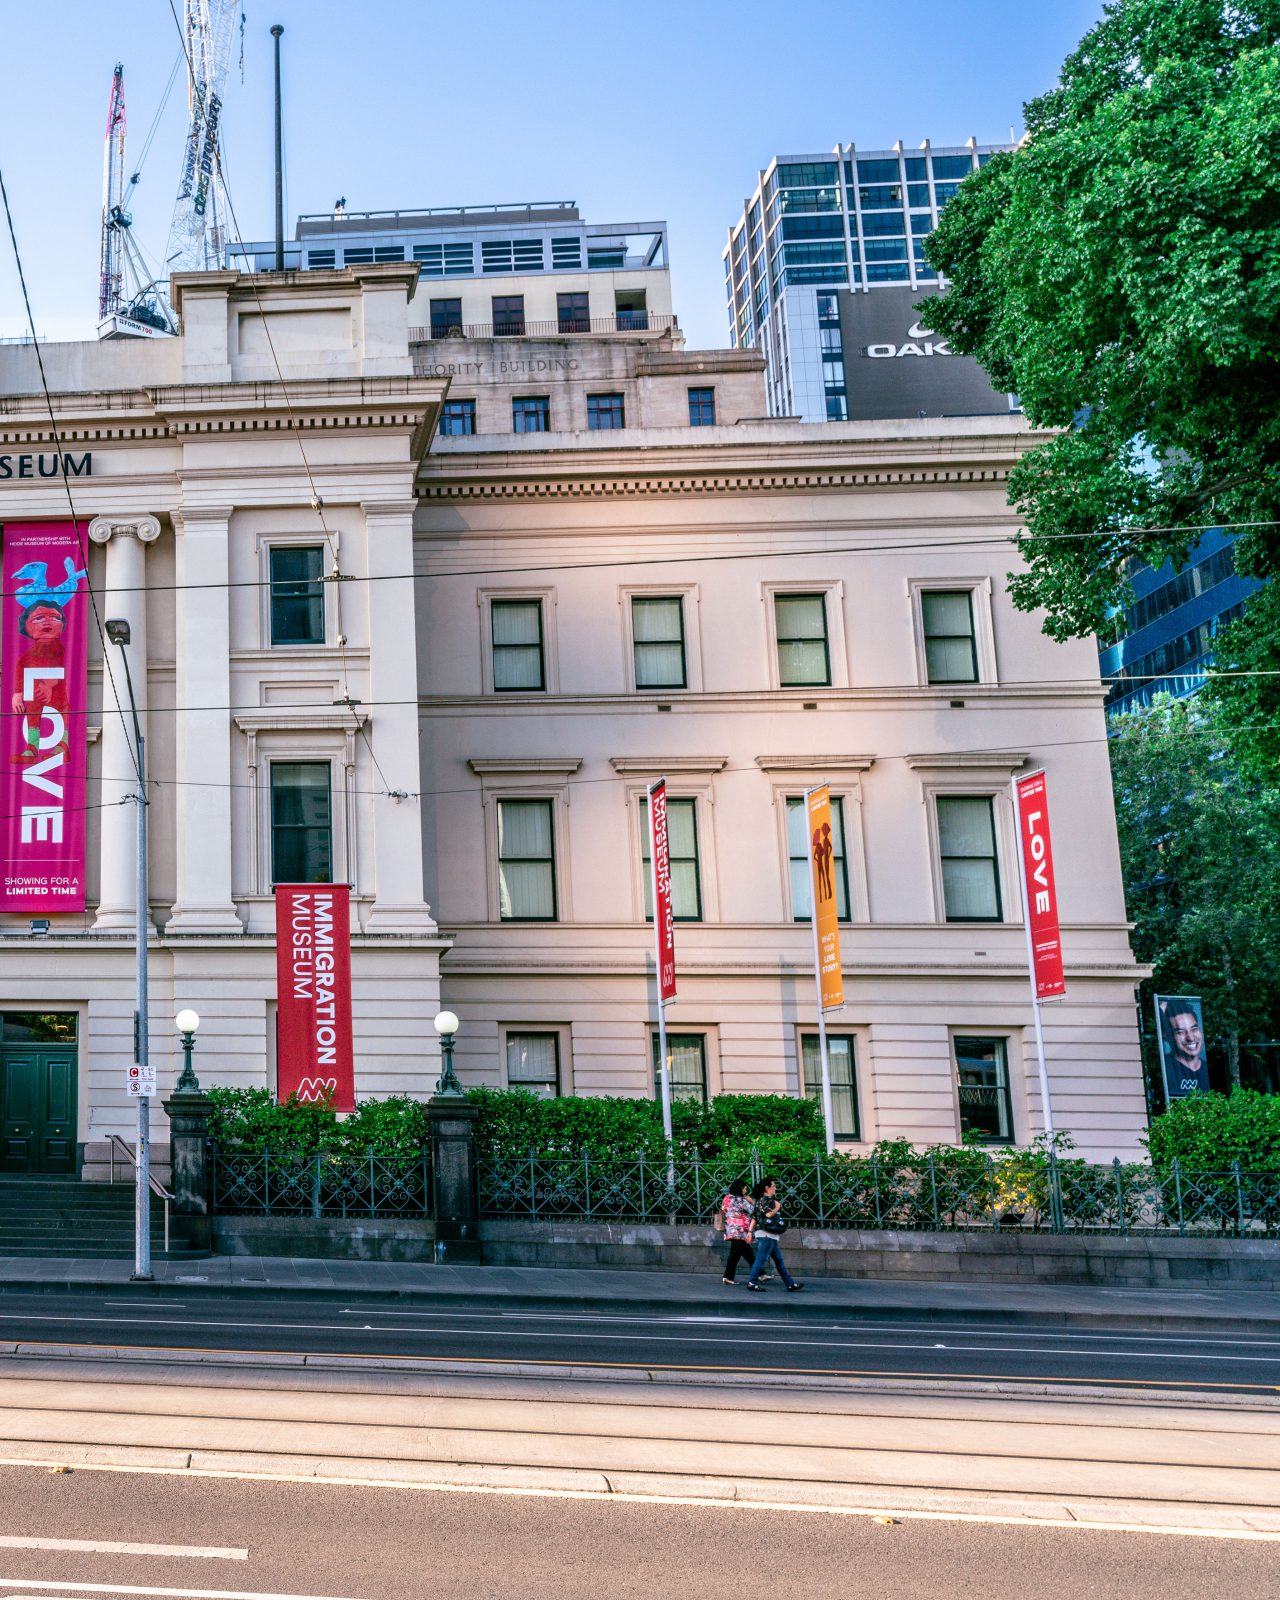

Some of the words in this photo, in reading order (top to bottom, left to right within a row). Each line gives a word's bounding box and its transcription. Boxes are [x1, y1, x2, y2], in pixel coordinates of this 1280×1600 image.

[124, 320, 141, 330] FORM
[867, 341, 963, 358] OAK
[500, 359, 579, 373] BUILDING
[21, 667, 65, 843] LOVE
[654, 797, 666, 893] MUSEUM
[1028, 811, 1050, 914] LOVE
[4, 877, 48, 885] SHOWING
[50, 877, 70, 885] FOR
[72, 877, 79, 885] A
[6, 887, 49, 895] LIMITED
[51, 887, 77, 895] TIME
[291, 894, 313, 998] MUSEUM
[314, 893, 337, 1064] IMMIGRATION
